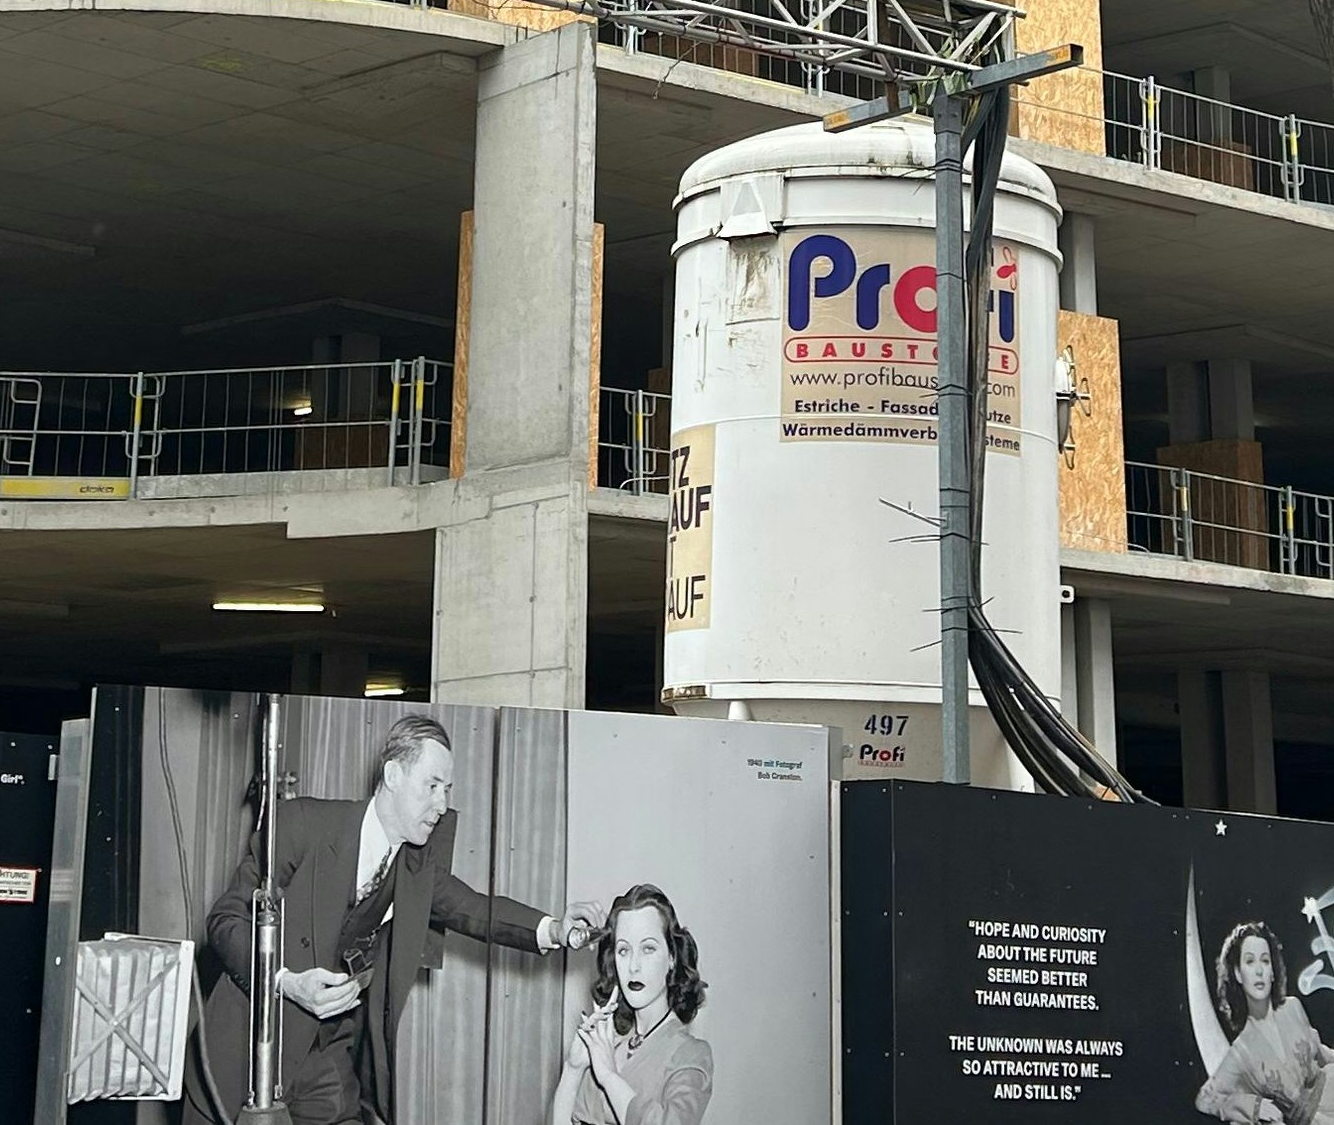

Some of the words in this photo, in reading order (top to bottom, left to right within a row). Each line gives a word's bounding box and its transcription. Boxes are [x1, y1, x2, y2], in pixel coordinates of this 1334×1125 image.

[795, 399, 860, 413] Estriche
[864, 714, 909, 736] 497
[859, 744, 906, 762] Profi
[1011, 923, 1040, 940] AND
[1041, 925, 1107, 944] CURIOSITY
[977, 943, 1021, 961] ABOUT
[1022, 946, 1048, 962] THE
[1049, 948, 1098, 966] FUTURE
[987, 967, 1039, 984] SEEMED
[1041, 970, 1088, 987] BETTER
[975, 989, 1011, 1006] THAN
[1013, 992, 1100, 1011] GUARANTEES.
[949, 1035, 975, 1051] THE
[977, 1036, 1044, 1054] UNKNOWN
[1045, 1038, 1073, 1055] WAS
[1075, 1040, 1124, 1057] ALWAYS
[962, 1059, 981, 1075] SO
[983, 1060, 1060, 1077] ATTRACTIVE
[1061, 1062, 1078, 1078] TO
[1080, 1063, 1099, 1078] ME
[993, 1083, 1023, 1100] AND
[1024, 1084, 1059, 1100] STILL
